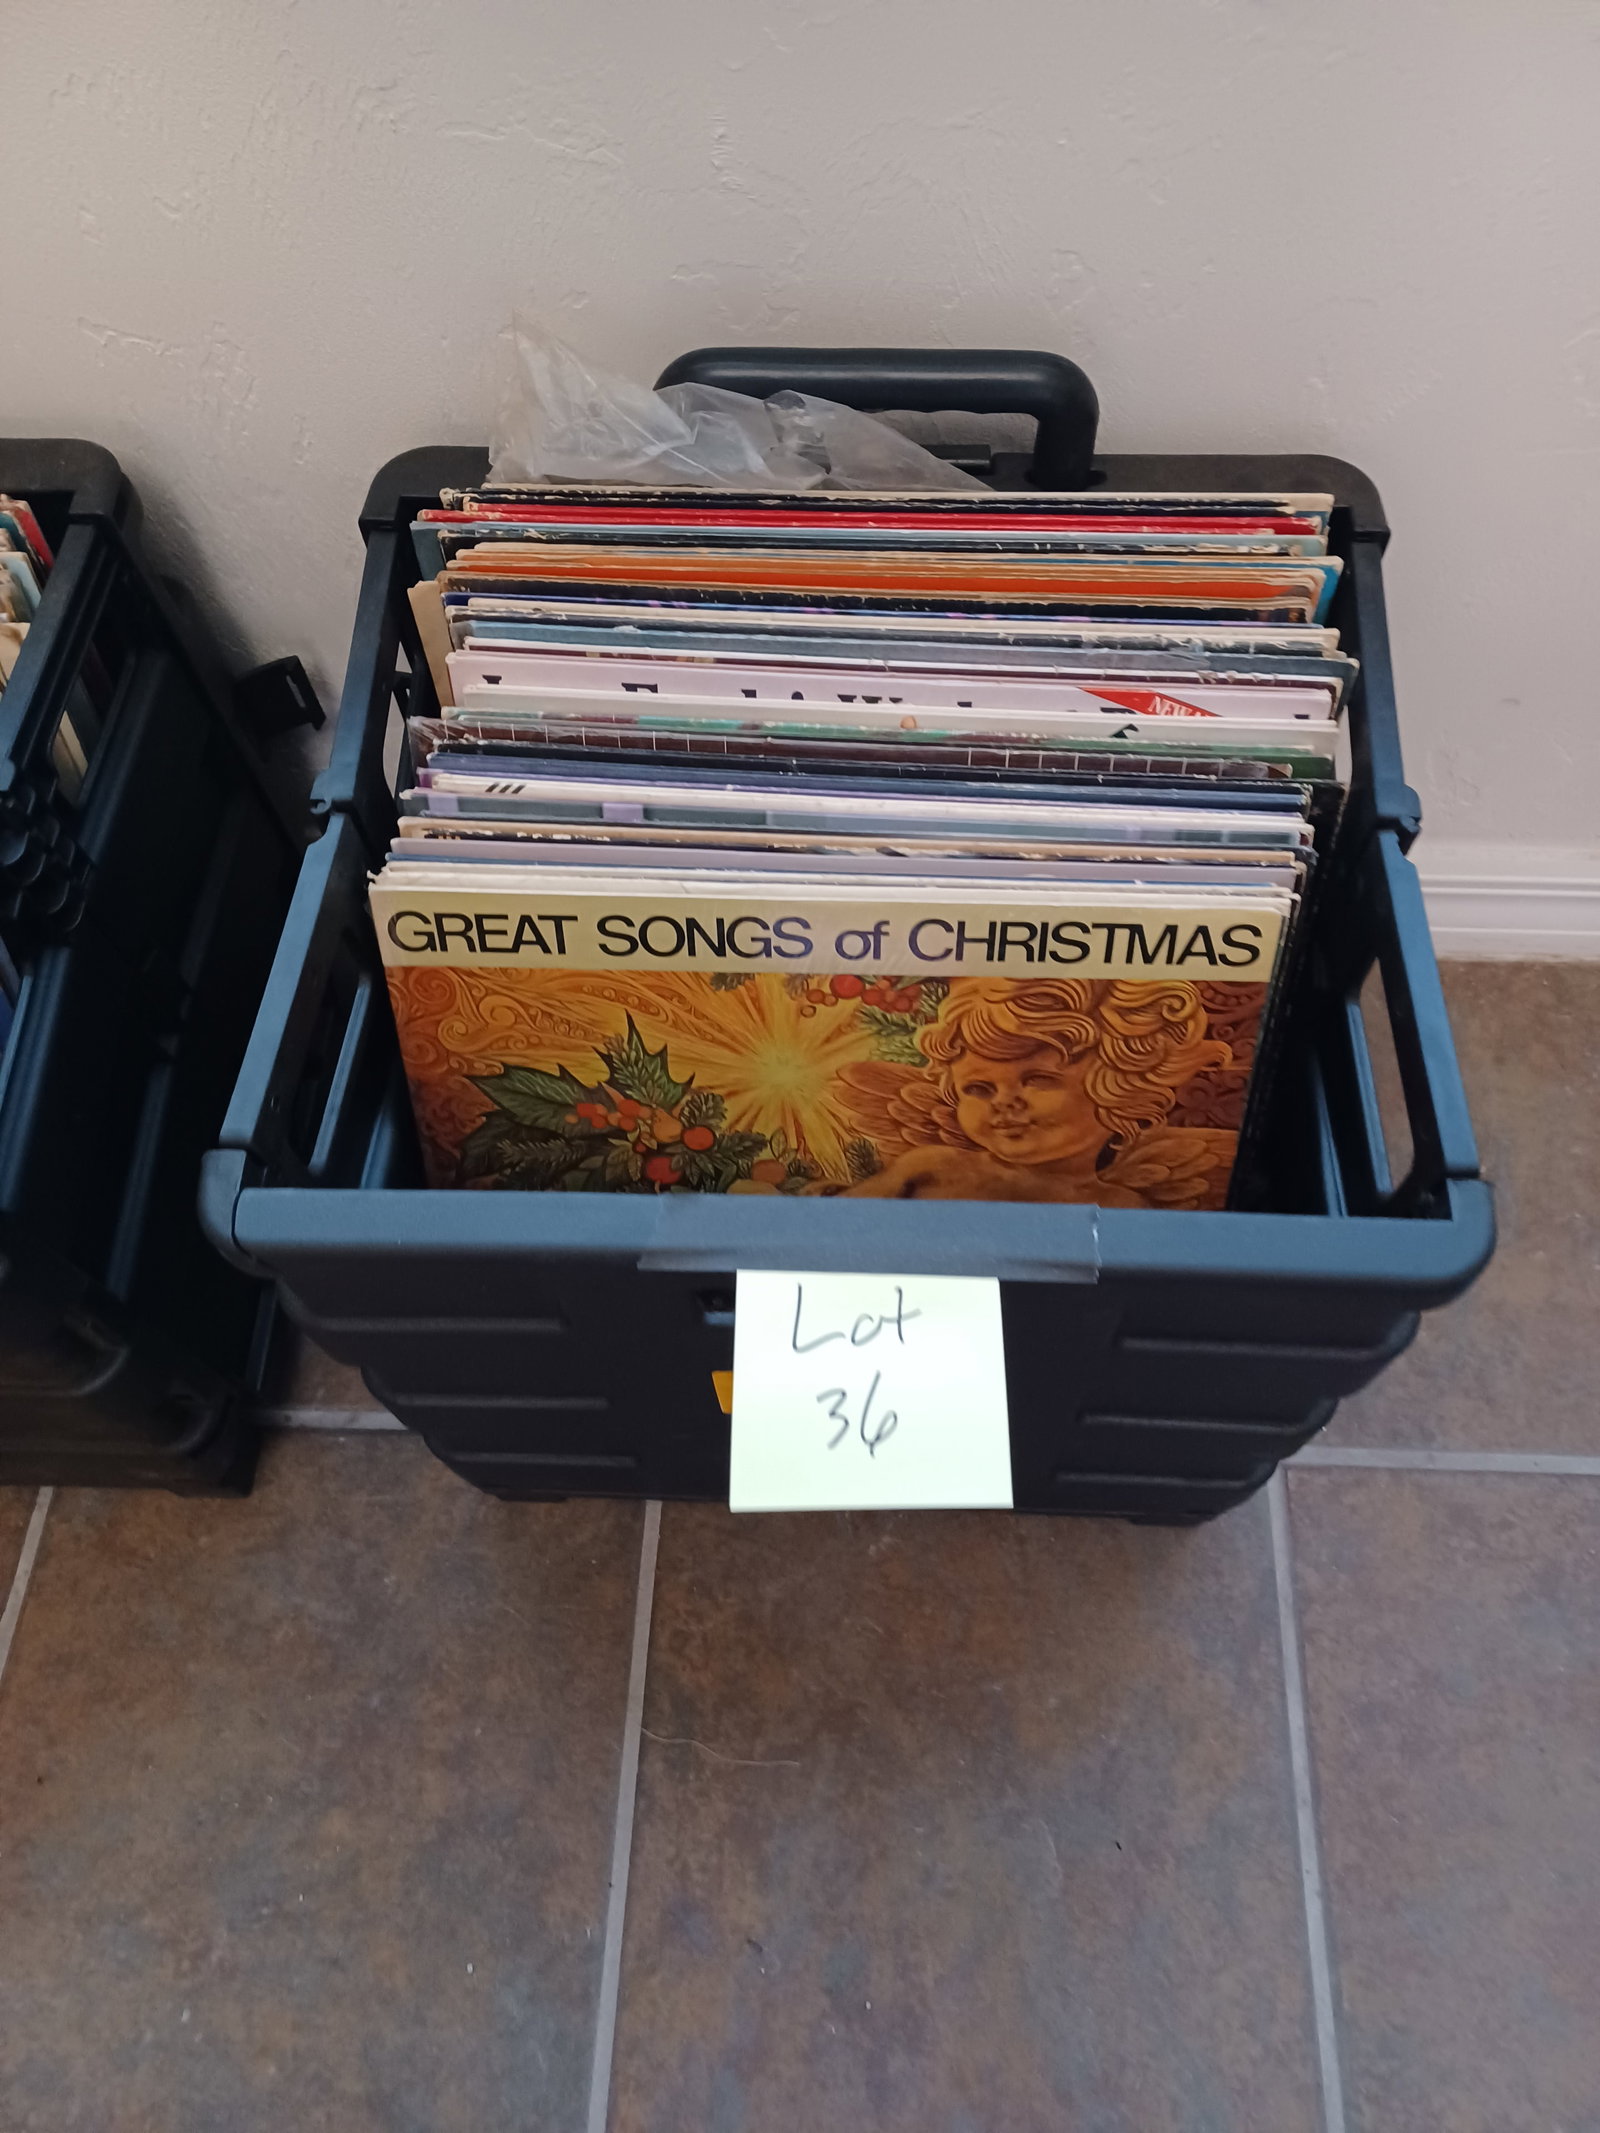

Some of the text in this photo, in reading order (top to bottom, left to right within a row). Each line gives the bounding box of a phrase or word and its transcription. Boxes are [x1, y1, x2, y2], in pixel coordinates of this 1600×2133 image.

[387, 910, 1263, 967] GREAT SONGS of CHRISTMAS
[792, 1283, 922, 1353] Lot
[816, 1371, 898, 1458] 36
